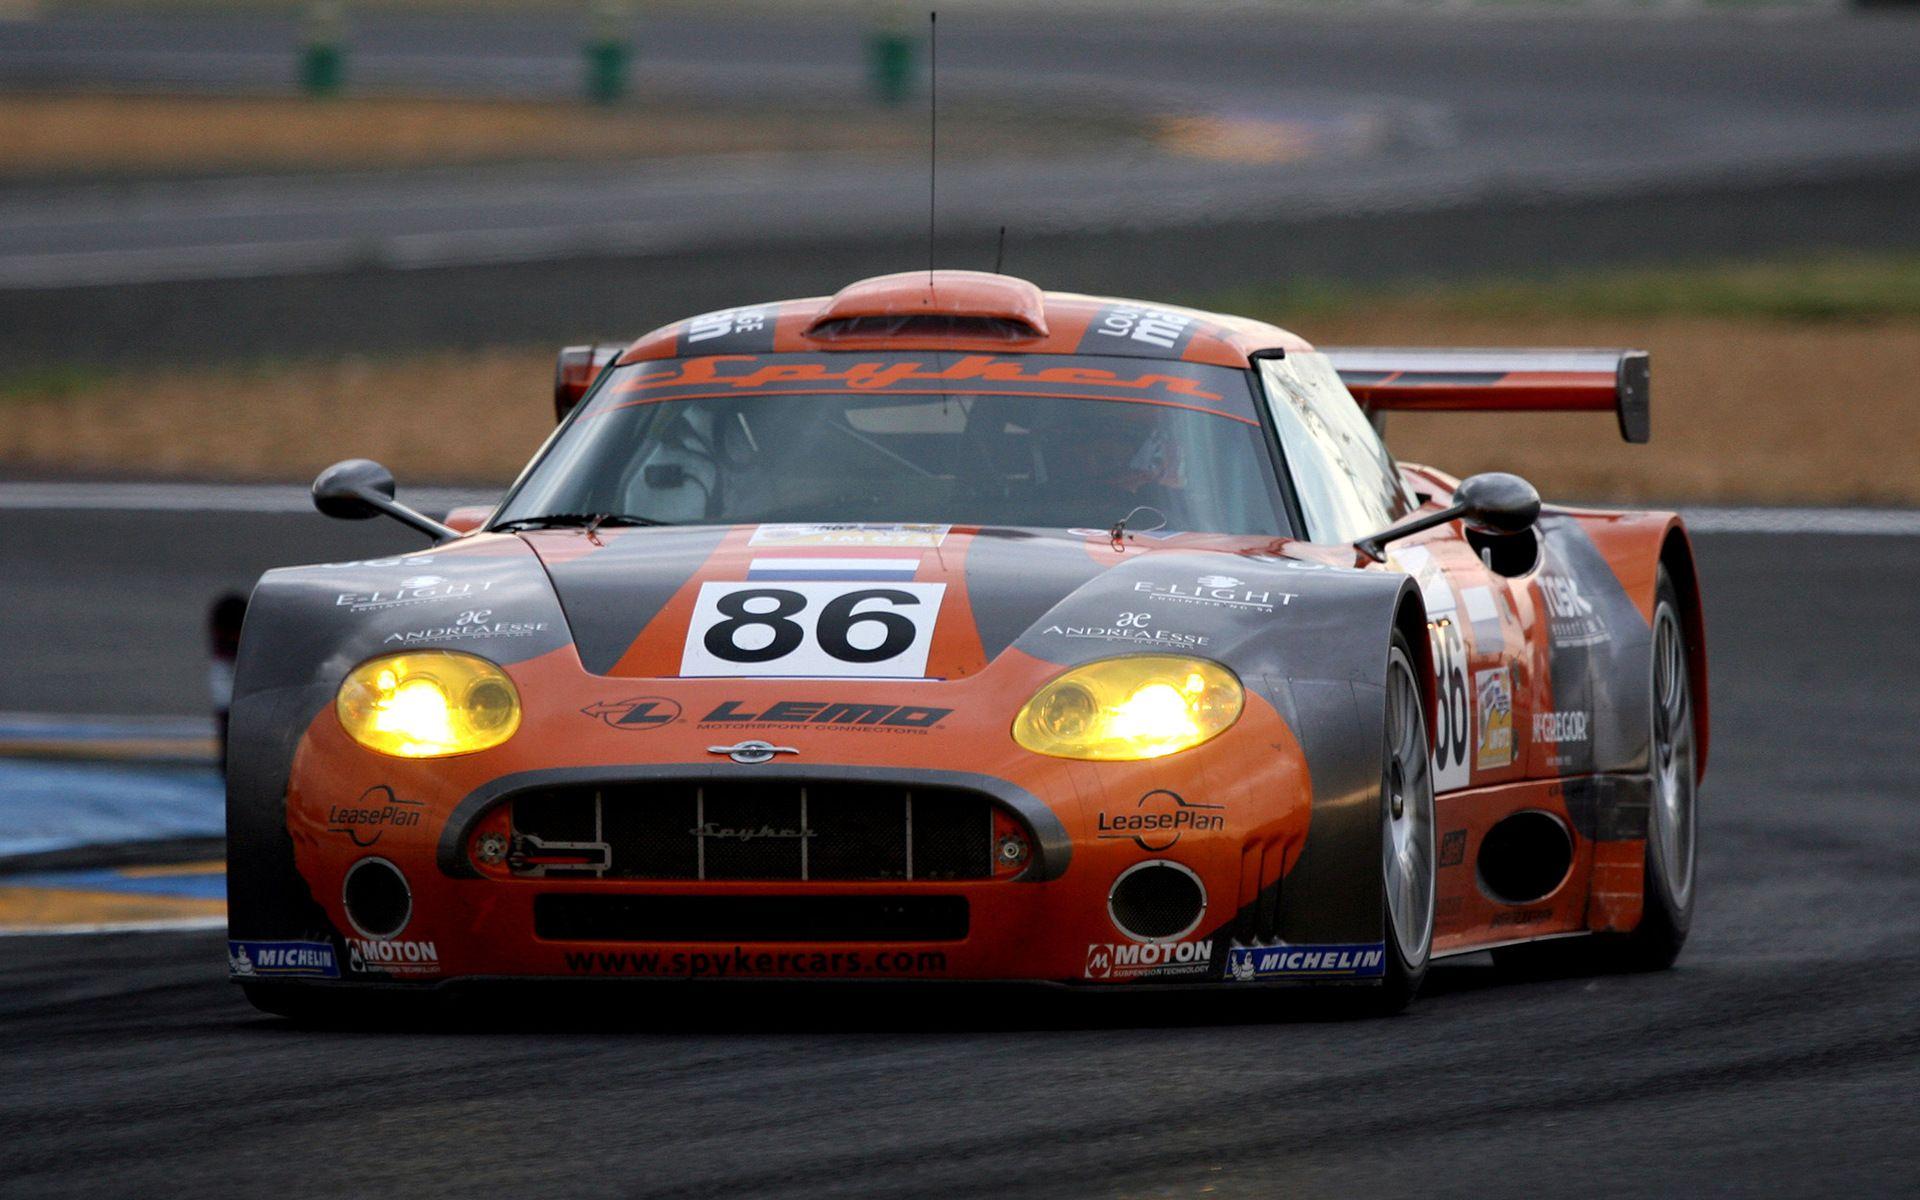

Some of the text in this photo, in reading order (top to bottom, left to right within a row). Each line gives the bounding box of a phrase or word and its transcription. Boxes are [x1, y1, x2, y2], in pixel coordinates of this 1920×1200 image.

[611, 355, 1223, 401] Spyker
[336, 581, 496, 606] E-LIGHT
[1134, 581, 1298, 605] E-LIGHT
[703, 588, 921, 663] 86
[700, 701, 955, 727] LEMO
[696, 722, 928, 735] MOTORSPORT CONNECTORS
[328, 805, 420, 828] LeasePlan
[1098, 809, 1224, 831] LeasePlan
[689, 822, 818, 841] Spyker
[257, 949, 332, 967] MICHELIN
[362, 940, 438, 962] MOTON
[564, 946, 949, 977] www.spykercars.com
[1114, 940, 1213, 965] MOTON
[1259, 951, 1383, 971] MICHELIN
[1163, 964, 1210, 976] TECHNOLOGY
